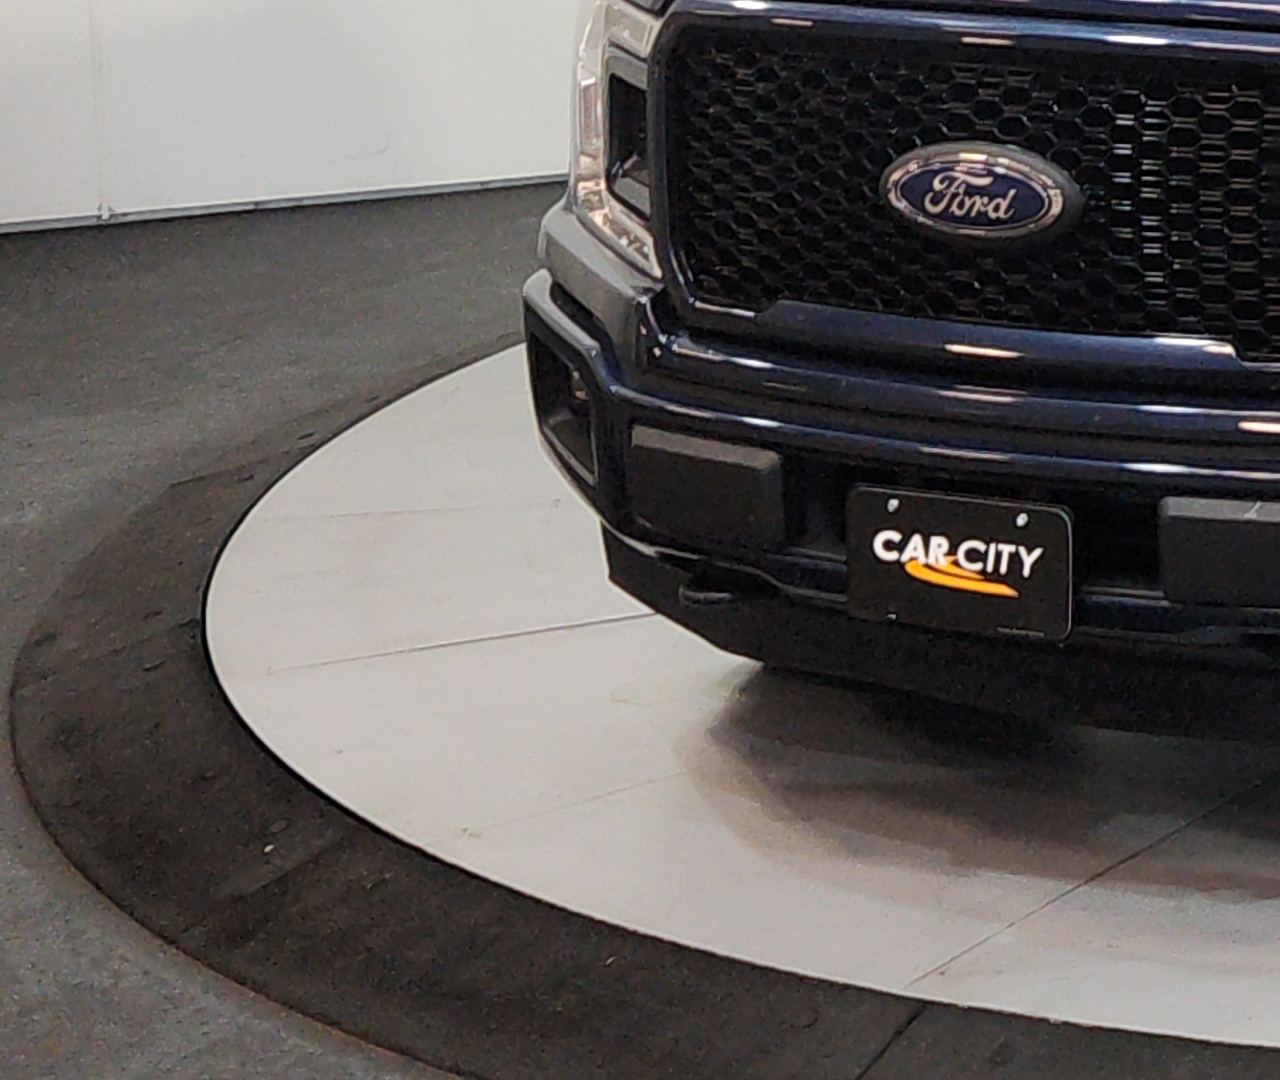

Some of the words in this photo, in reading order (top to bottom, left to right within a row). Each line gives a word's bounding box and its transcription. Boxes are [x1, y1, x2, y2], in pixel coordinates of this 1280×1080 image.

[924, 170, 1014, 220] Ford
[873, 529, 950, 568] CAR
[956, 539, 1044, 578] CITY
